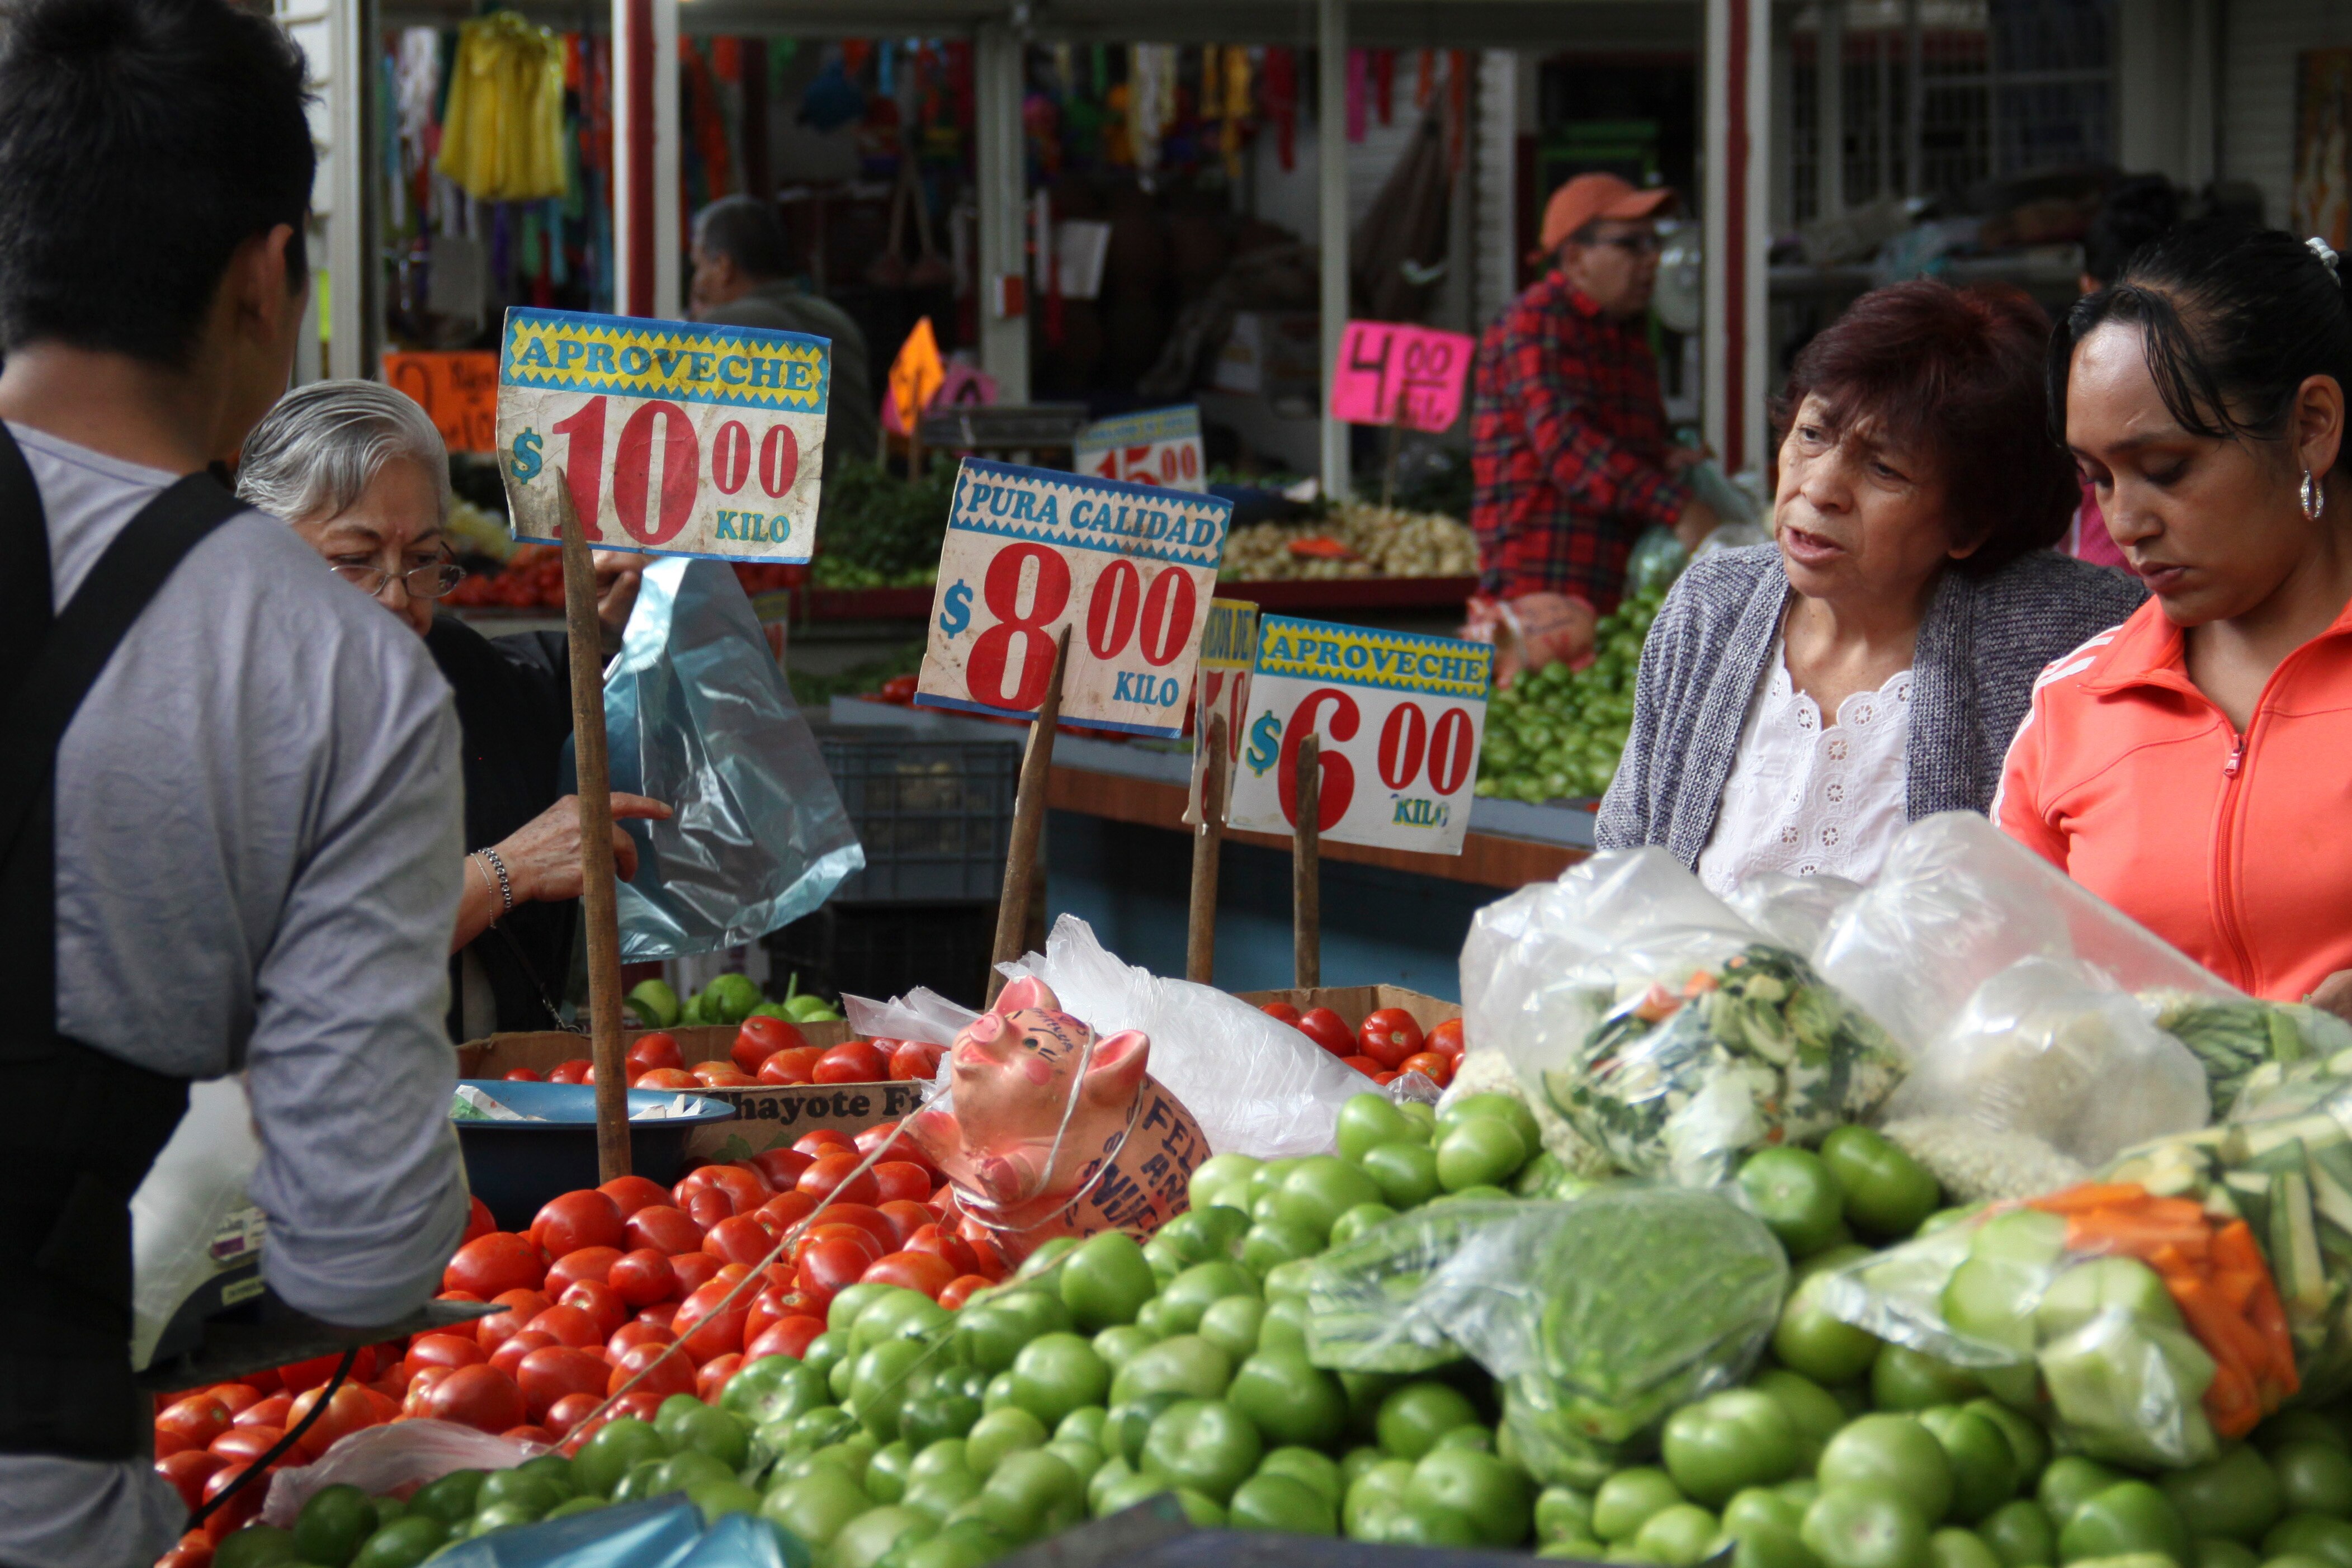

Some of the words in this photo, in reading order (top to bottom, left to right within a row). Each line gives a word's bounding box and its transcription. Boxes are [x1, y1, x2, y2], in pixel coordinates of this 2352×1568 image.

[517, 337, 813, 391] APROVECHE
[1350, 330, 1393, 416] 4
[715, 510, 791, 543] KILO
[967, 483, 1059, 525] PURA
[1070, 500, 1216, 548] CALIDAD
[1267, 635, 1485, 683] APROVECHE
[1113, 672, 1179, 708] KILO
